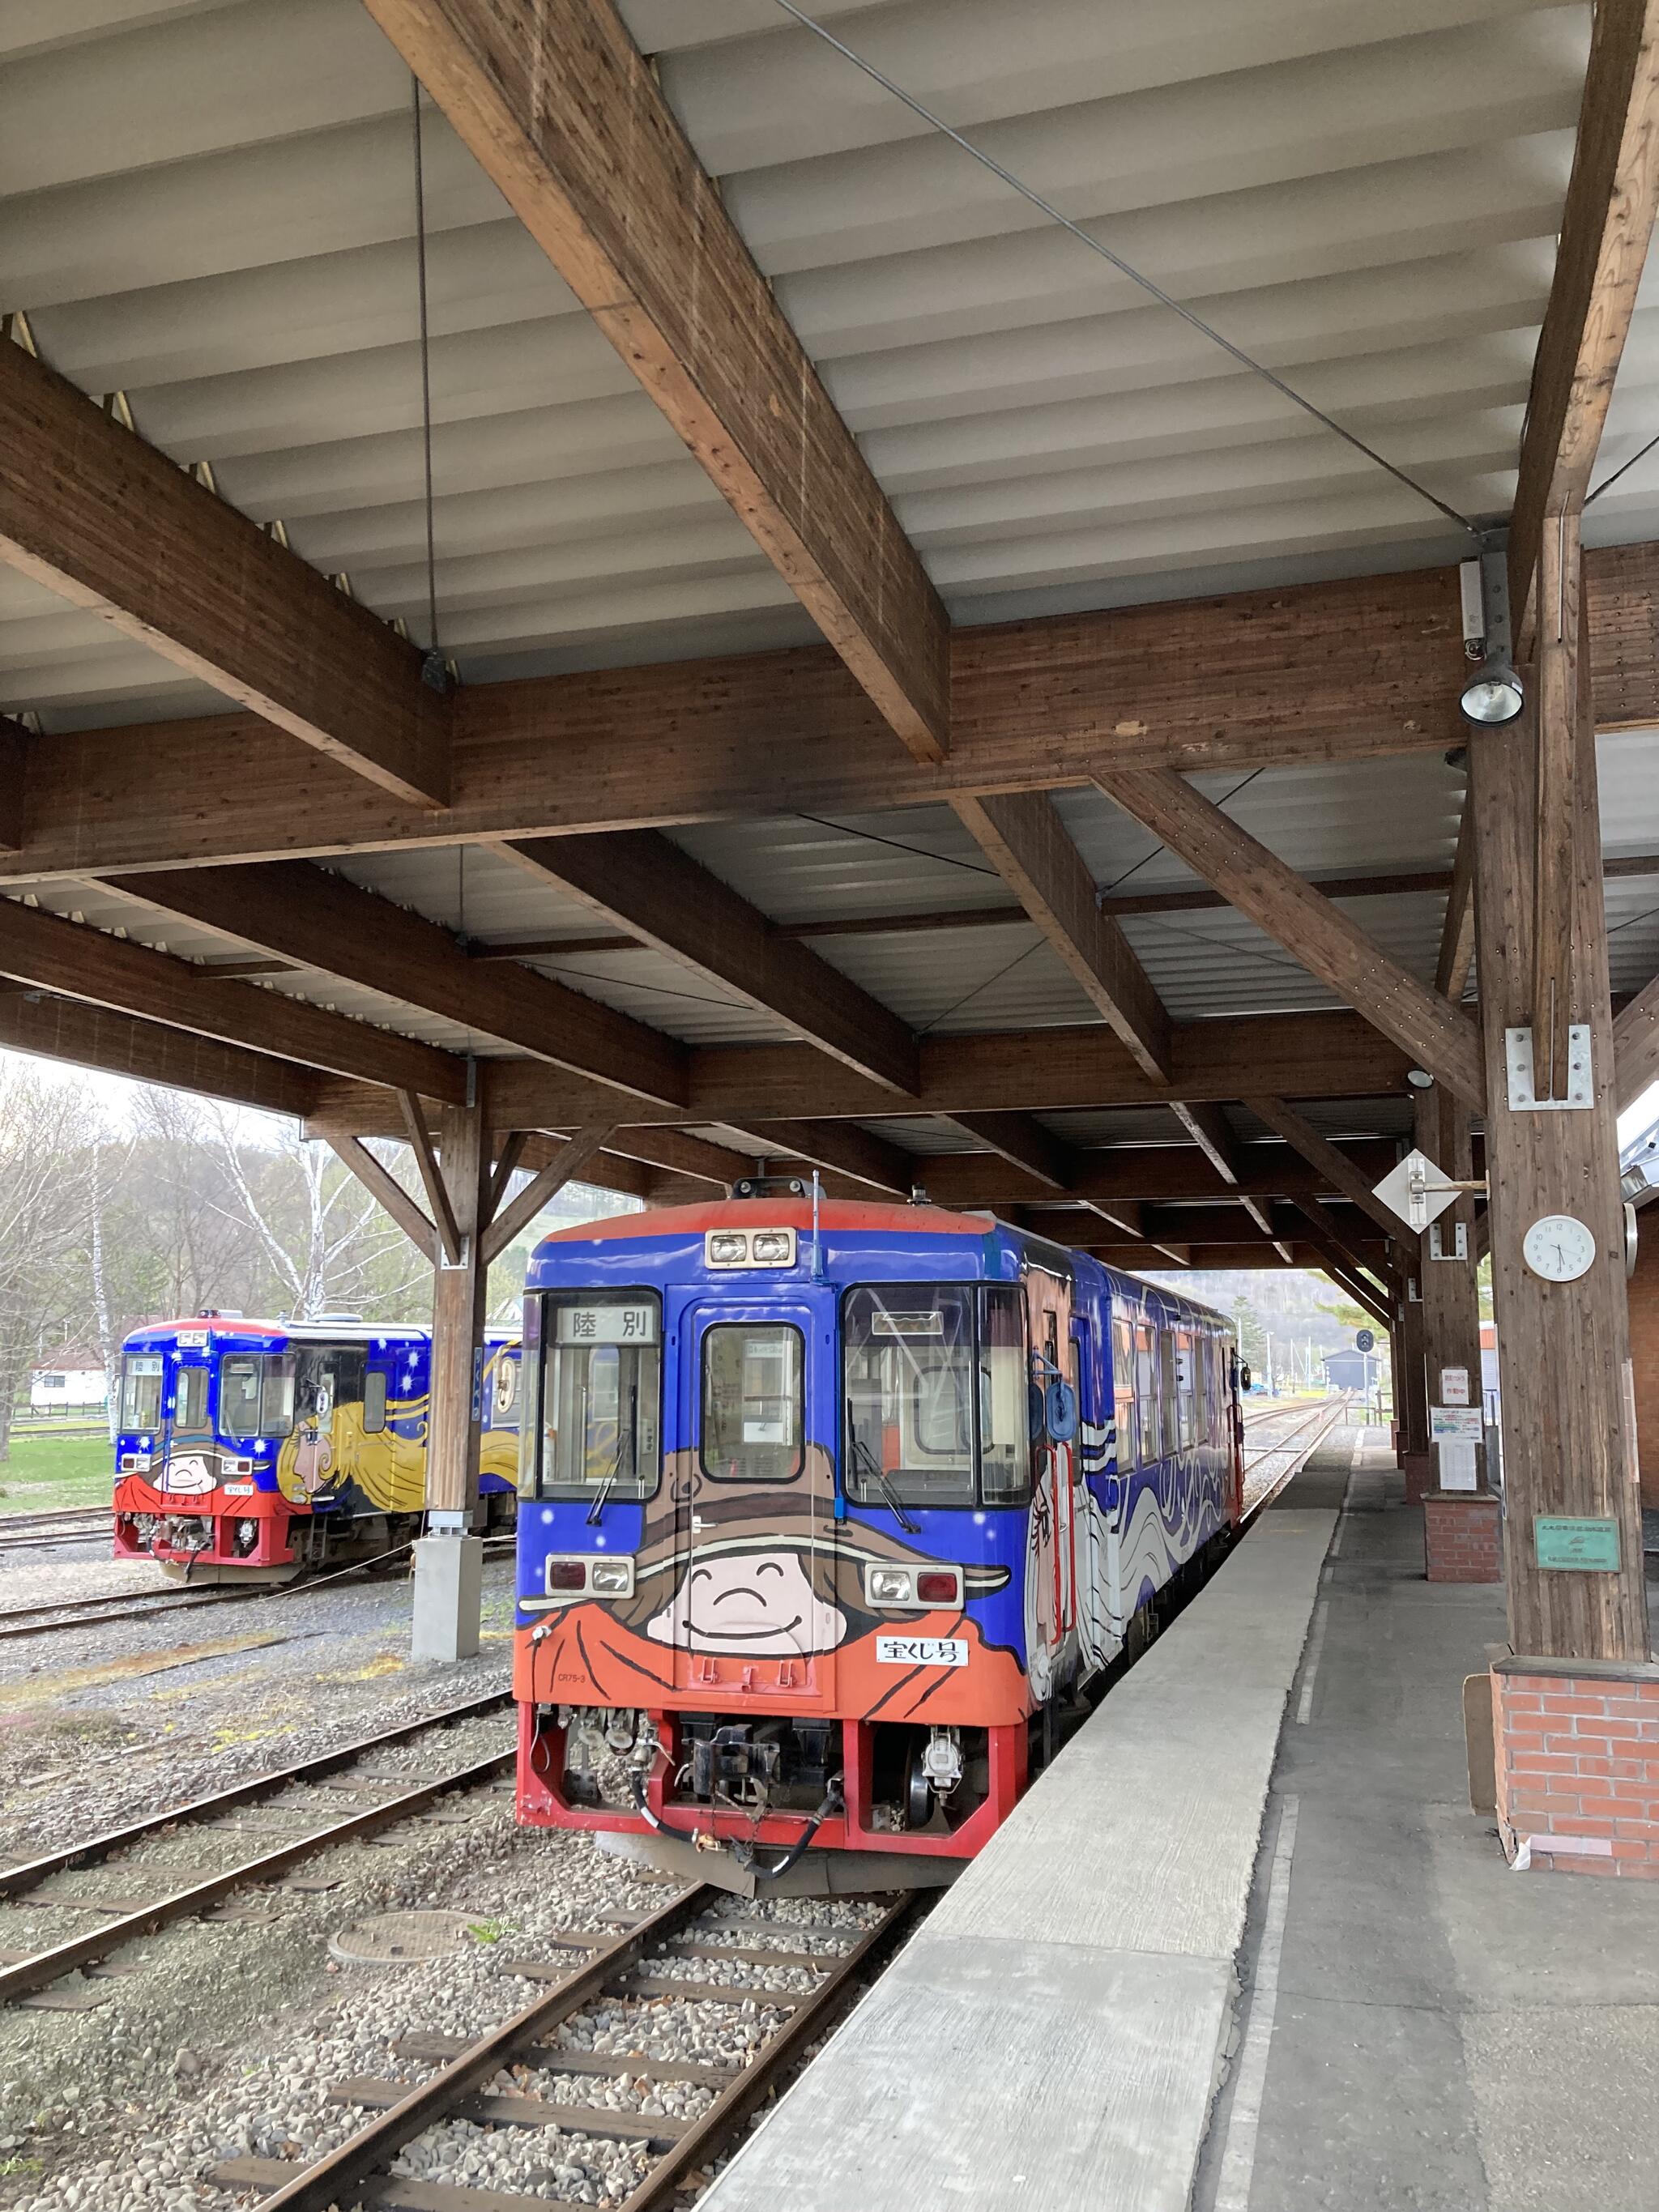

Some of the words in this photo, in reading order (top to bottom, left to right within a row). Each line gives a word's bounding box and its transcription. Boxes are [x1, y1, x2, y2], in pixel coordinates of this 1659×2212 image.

[573, 1311, 646, 1337] 陸別
[884, 1641, 959, 1662] 宝くじ号
[558, 1673, 586, 1683] CR75-3
